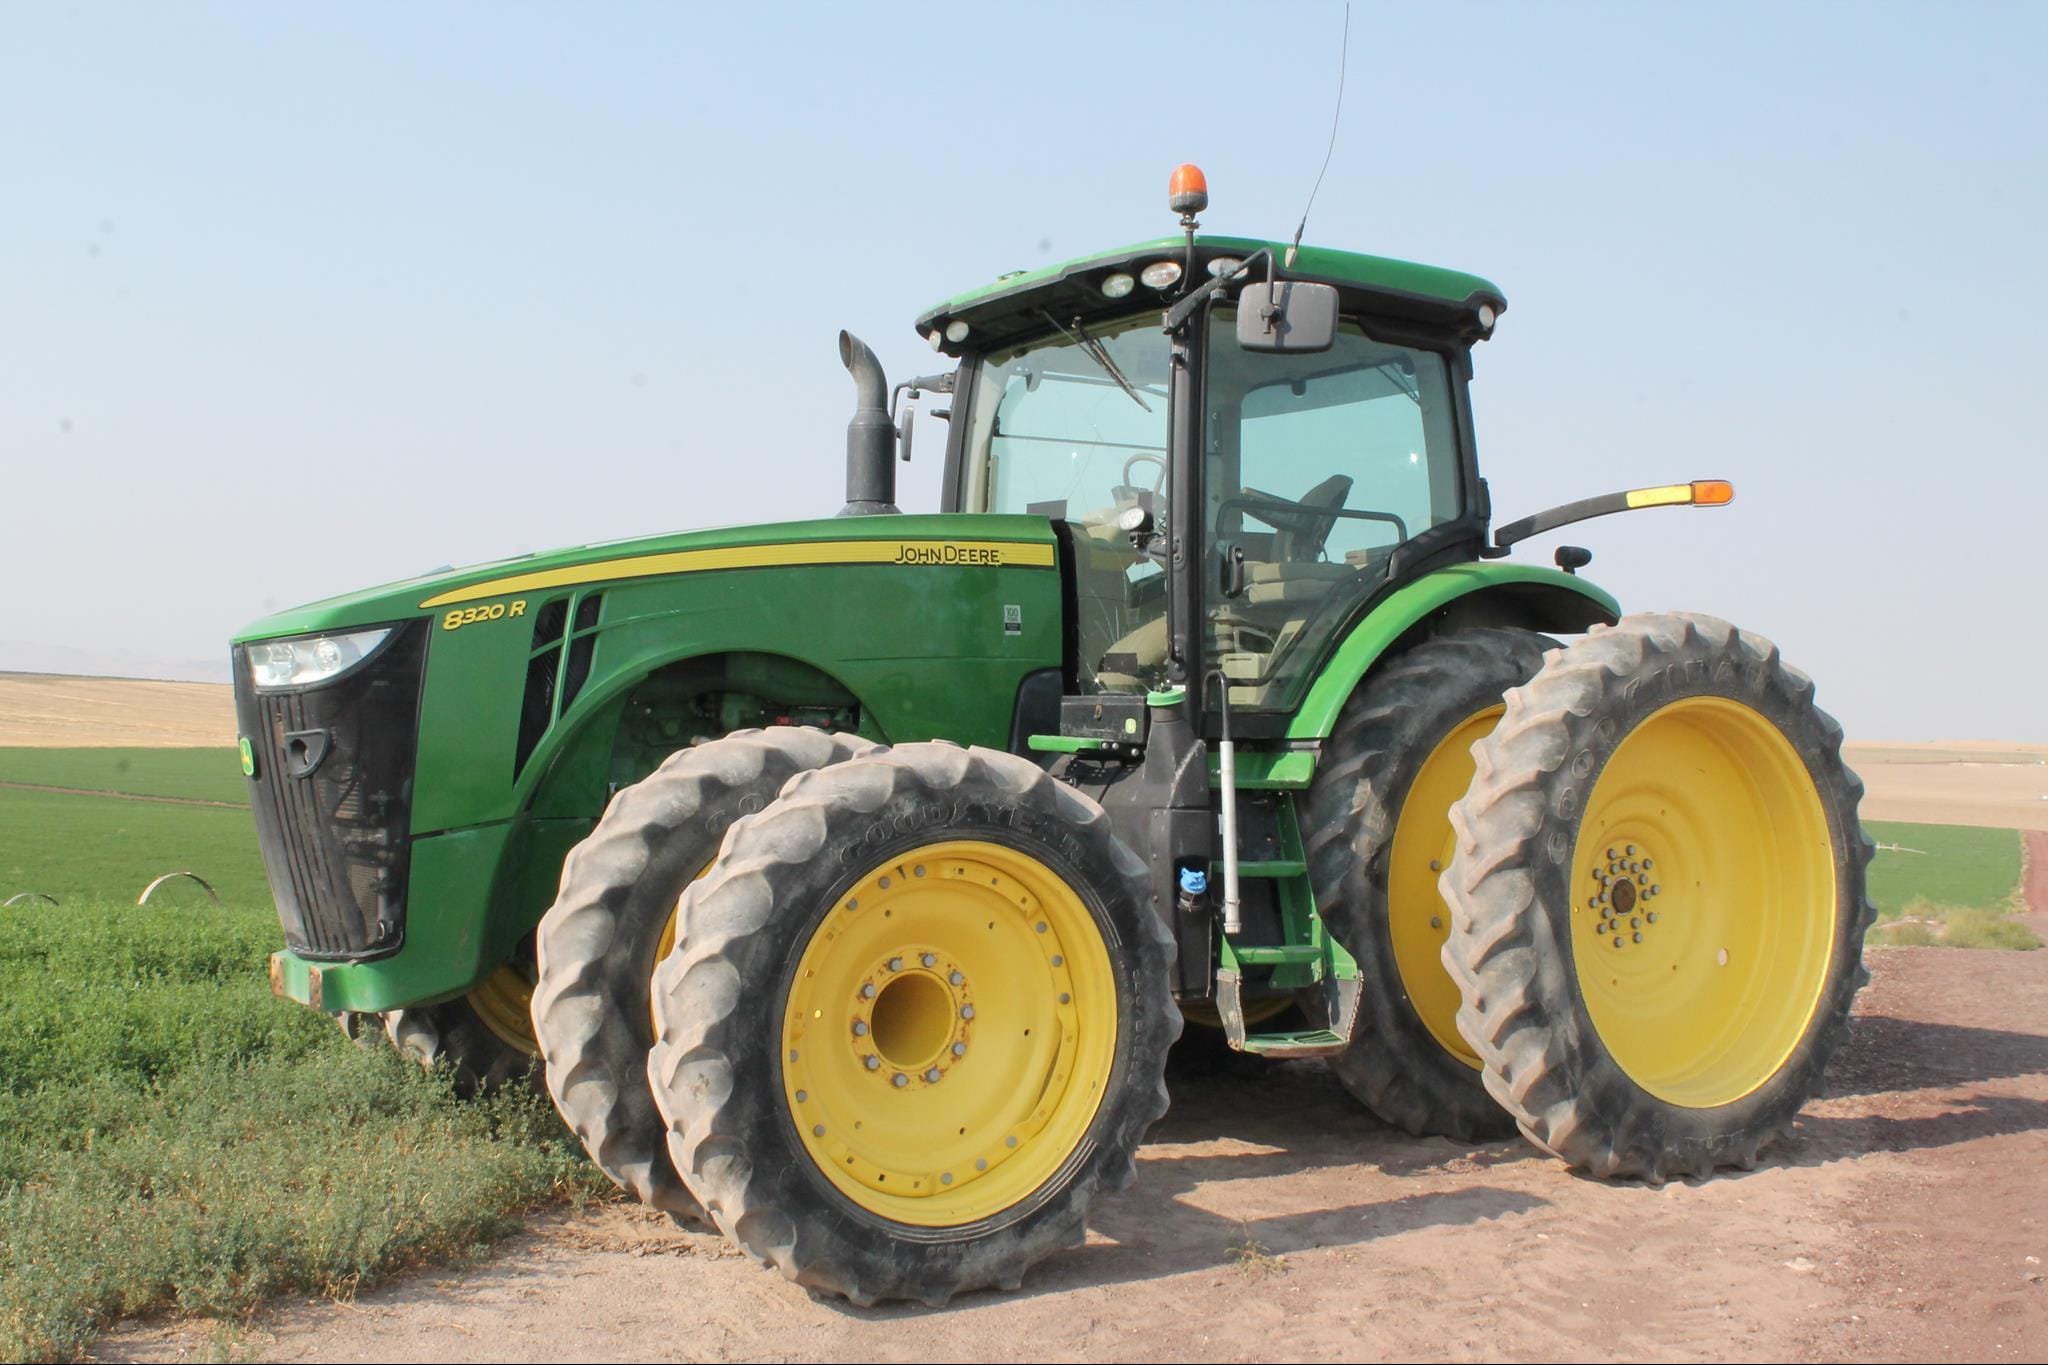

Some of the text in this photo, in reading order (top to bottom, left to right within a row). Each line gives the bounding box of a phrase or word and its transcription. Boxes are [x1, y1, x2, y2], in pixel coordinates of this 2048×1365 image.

[895, 545, 1000, 563] JOHN DEERE
[443, 600, 526, 630] 8320 R
